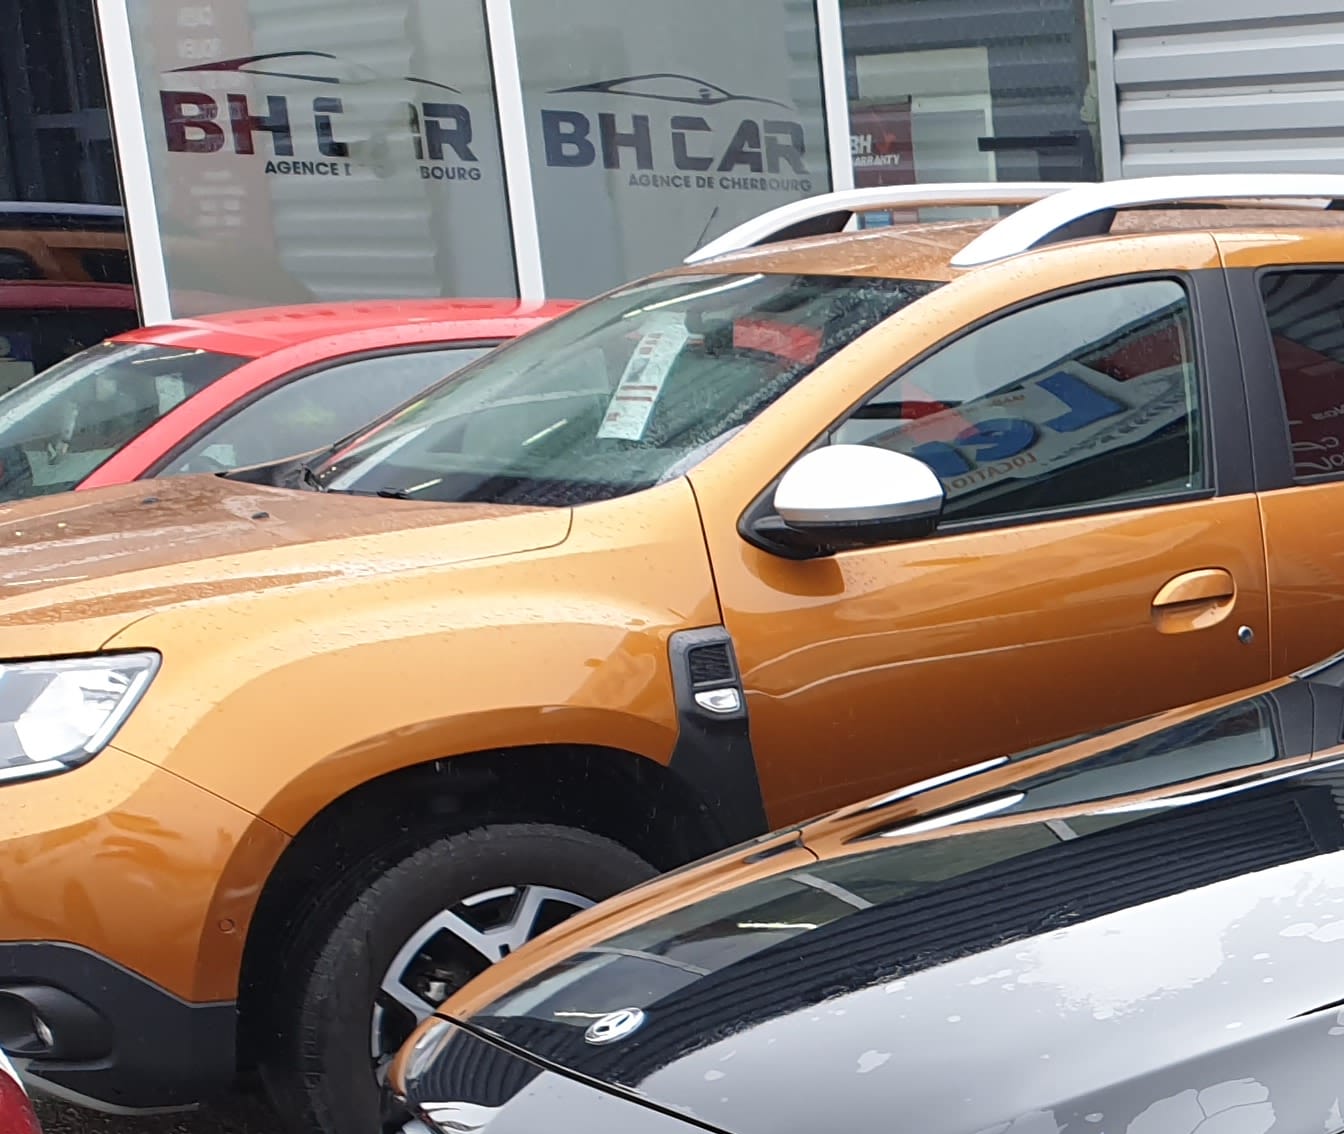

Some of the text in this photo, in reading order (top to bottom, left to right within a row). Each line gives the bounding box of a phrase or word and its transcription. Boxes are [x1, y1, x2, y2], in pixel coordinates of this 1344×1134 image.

[159, 90, 478, 162] BH CR
[541, 109, 811, 175] BH CAR
[265, 160, 340, 176] AGENCE
[854, 153, 900, 167] ARRANTY
[629, 173, 812, 192] AGENCE DE CHERBOURG
